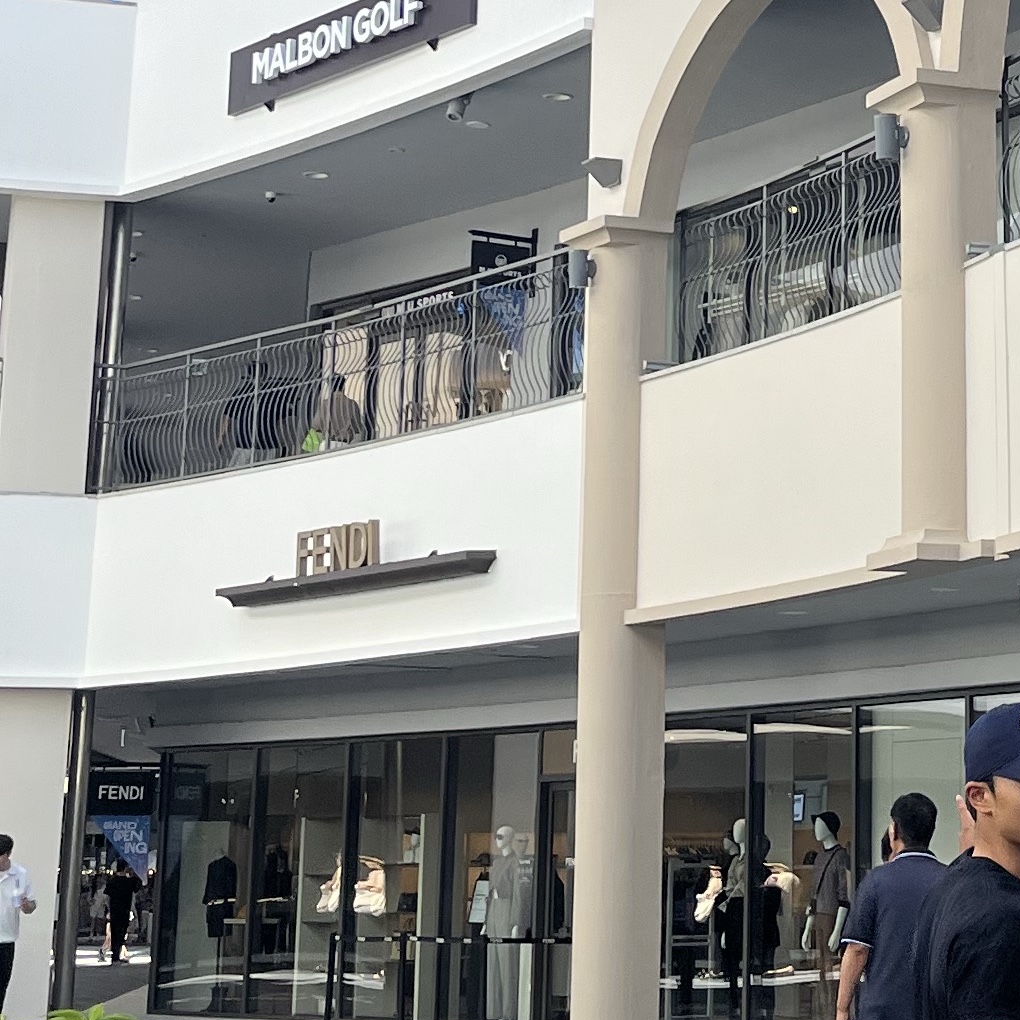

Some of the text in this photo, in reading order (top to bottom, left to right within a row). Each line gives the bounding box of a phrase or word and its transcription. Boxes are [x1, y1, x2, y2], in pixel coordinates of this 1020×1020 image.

[252, 0, 424, 84] MALBON GOLF
[296, 519, 380, 577] FENDI
[98, 785, 145, 800] FENDI
